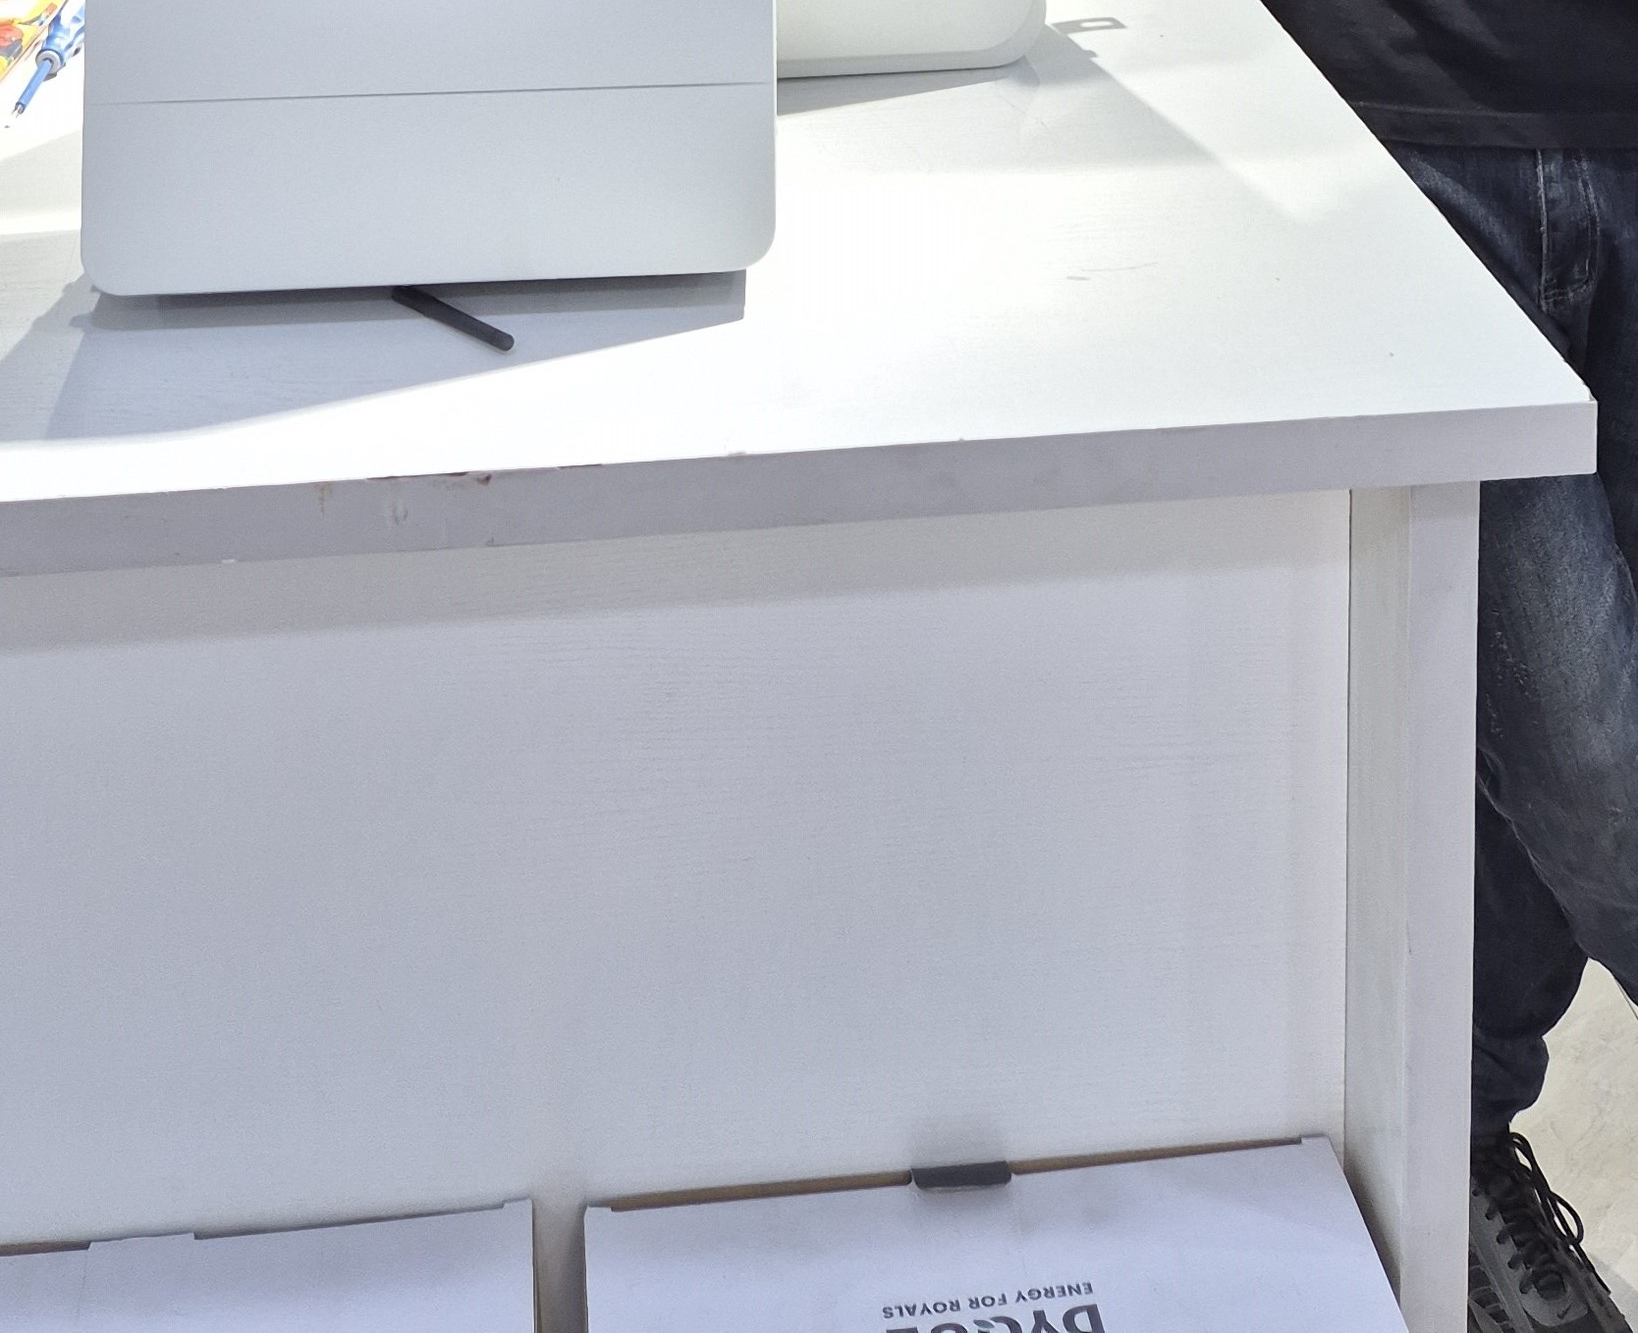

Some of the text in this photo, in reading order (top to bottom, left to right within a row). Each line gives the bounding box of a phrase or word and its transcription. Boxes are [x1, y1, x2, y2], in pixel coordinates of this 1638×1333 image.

[882, 1281, 1094, 1319] ENERGY FOR ROYALS
